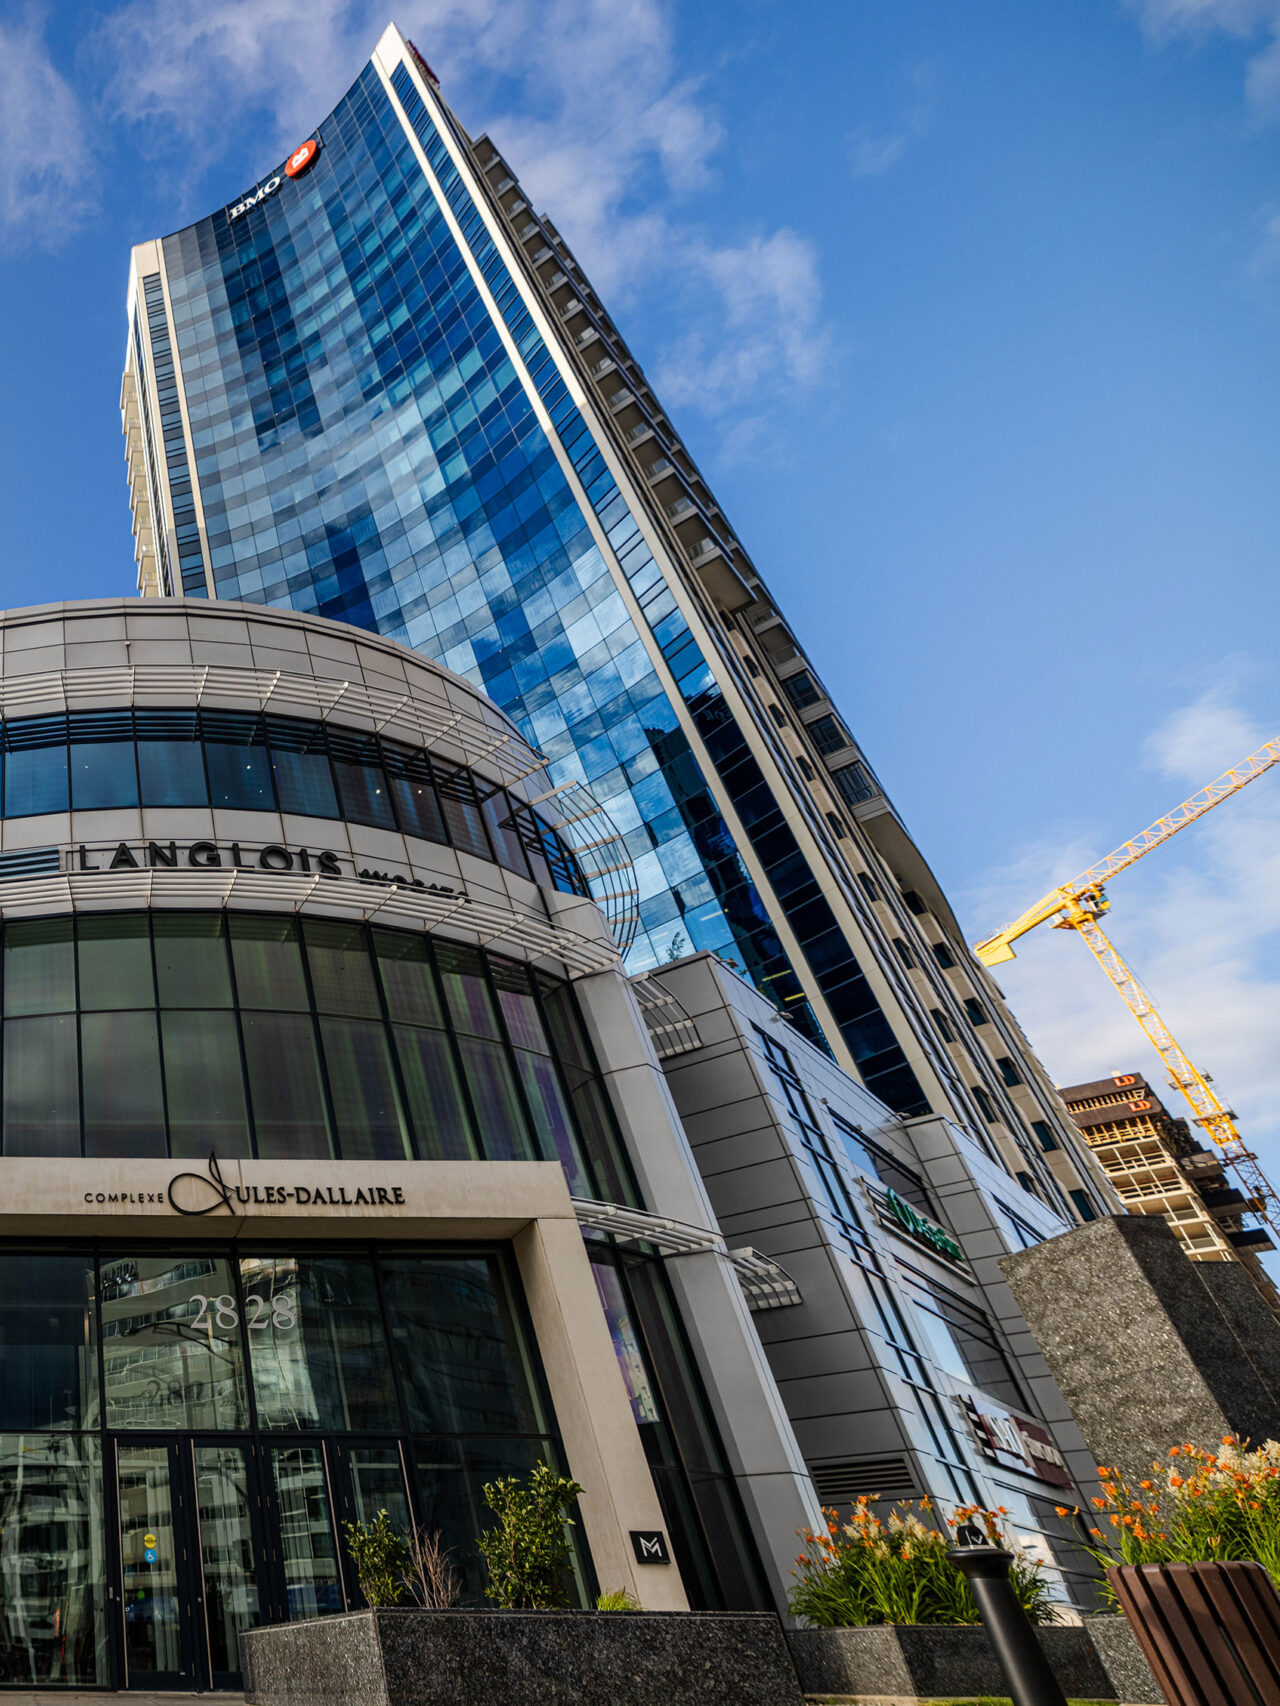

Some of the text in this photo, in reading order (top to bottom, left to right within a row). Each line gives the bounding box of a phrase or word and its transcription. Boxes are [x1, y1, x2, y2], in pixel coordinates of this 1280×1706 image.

[230, 176, 281, 219] BMO
[79, 841, 340, 877] LANGLOIS
[84, 1192, 164, 1204] COMPLEXE
[189, 1295, 296, 1329] 2828
